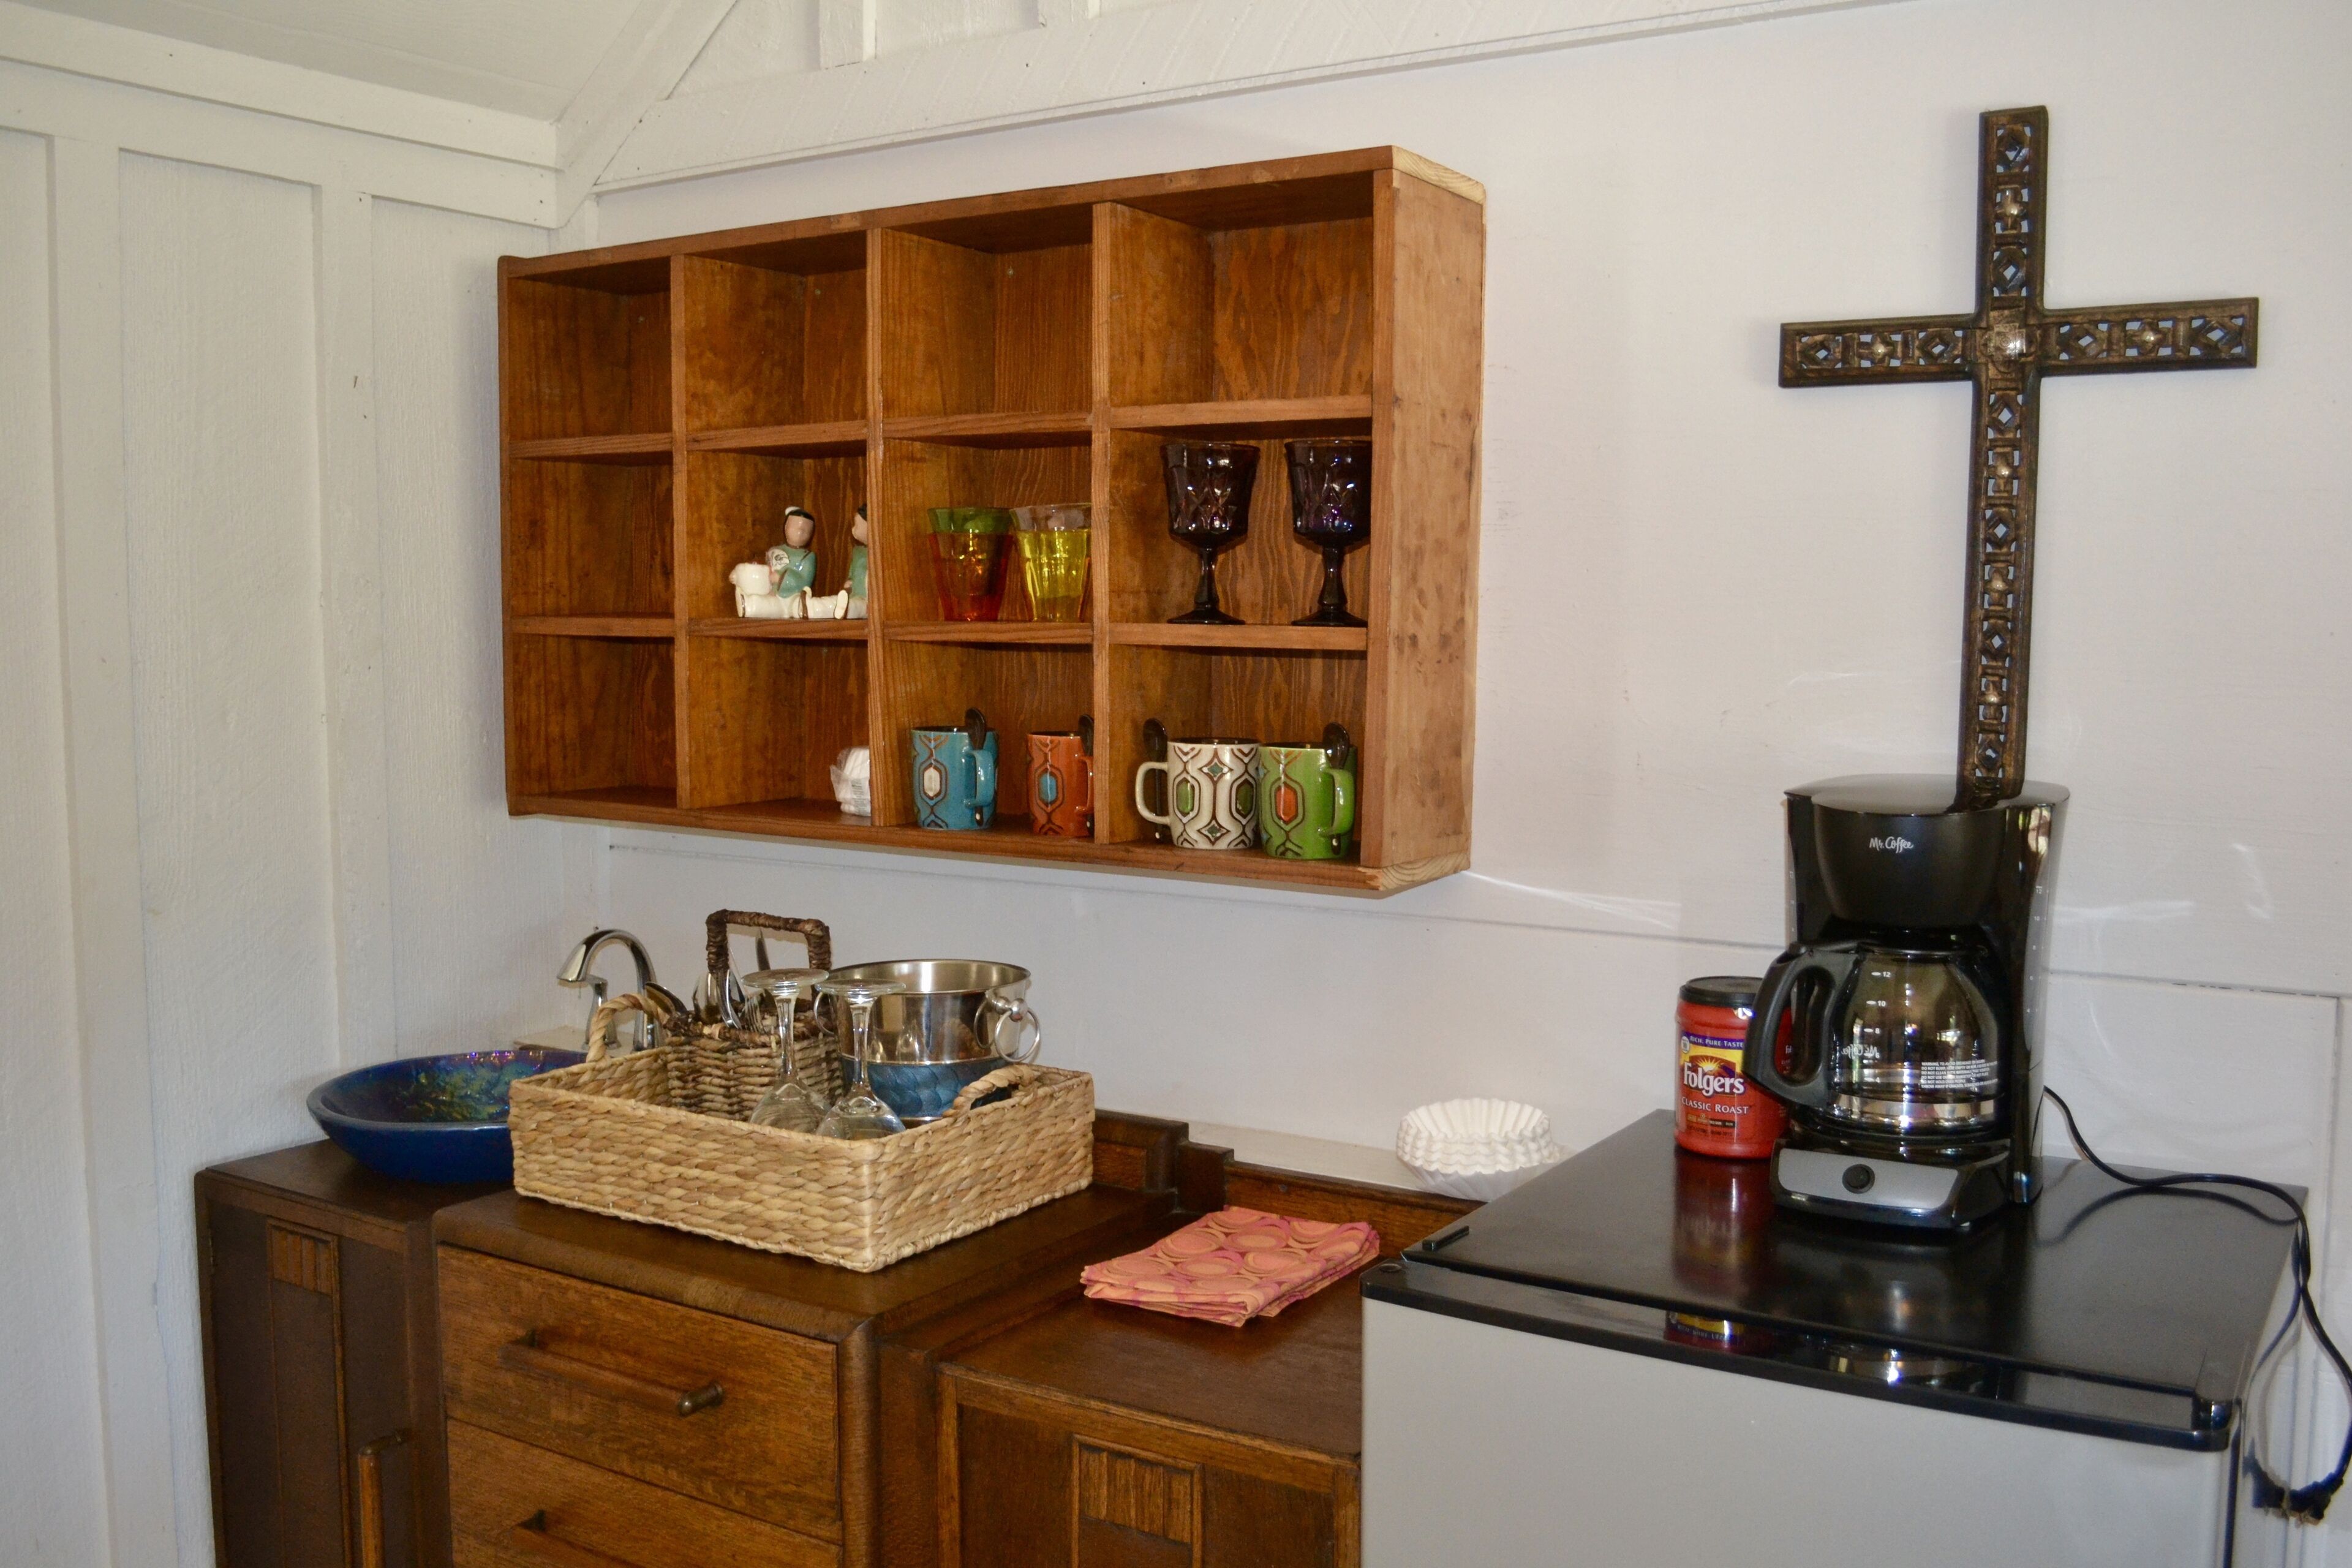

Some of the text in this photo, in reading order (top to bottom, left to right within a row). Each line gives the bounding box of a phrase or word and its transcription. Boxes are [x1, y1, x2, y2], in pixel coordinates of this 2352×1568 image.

[1869, 836, 1914, 853] Mr. Coffee
[1684, 1061, 1745, 1096] Folgers
[1682, 1096, 1749, 1114] CLASSIC ROAST
